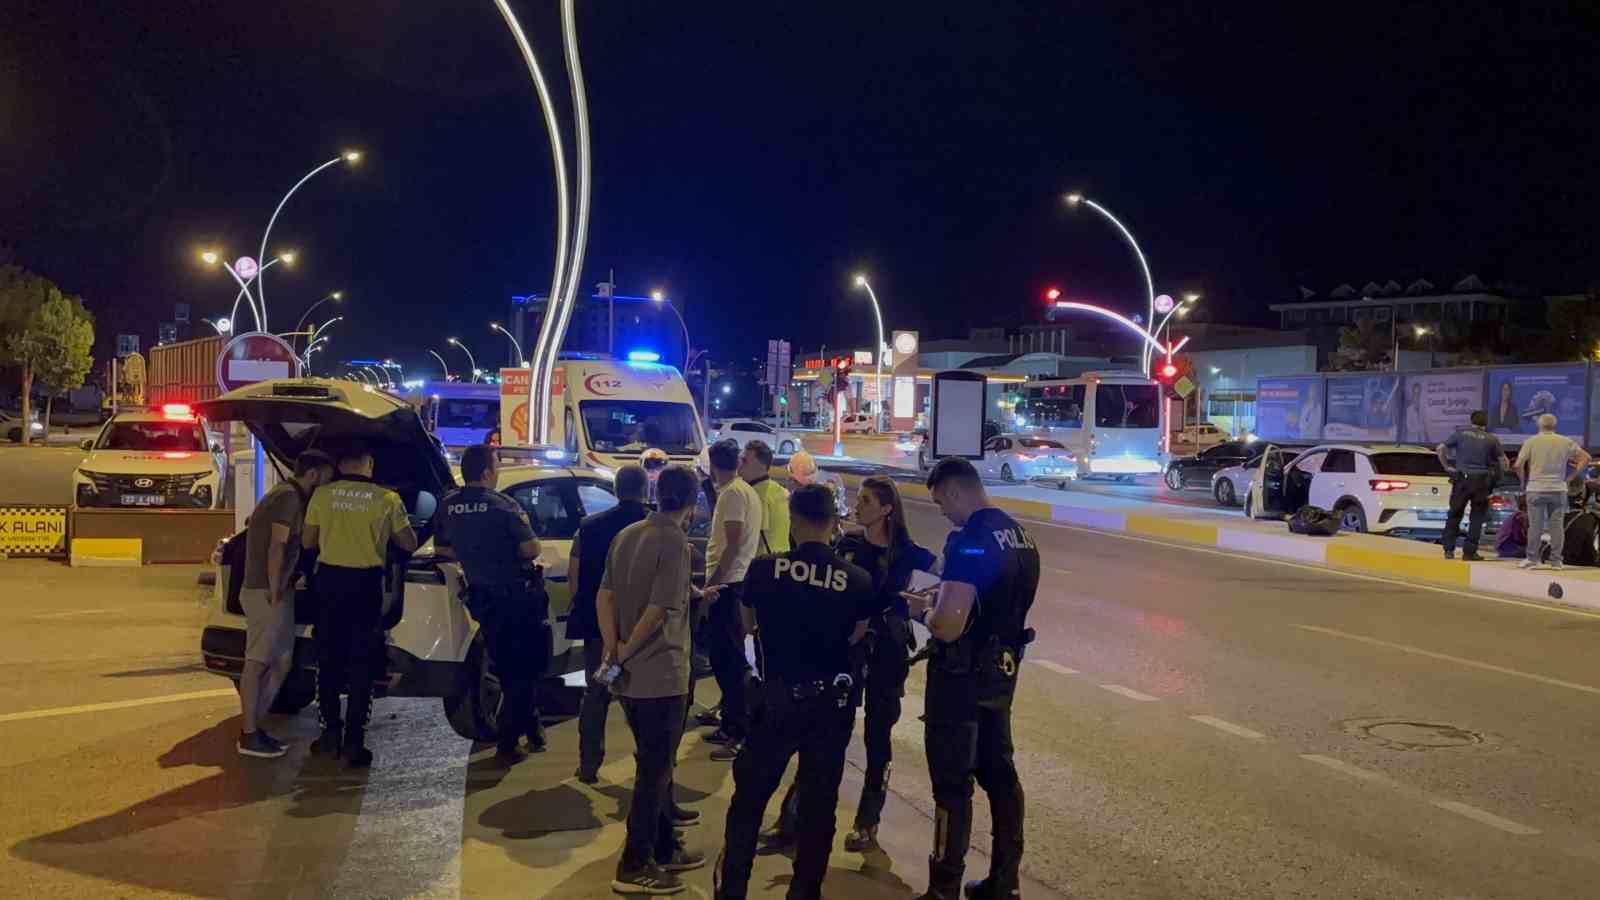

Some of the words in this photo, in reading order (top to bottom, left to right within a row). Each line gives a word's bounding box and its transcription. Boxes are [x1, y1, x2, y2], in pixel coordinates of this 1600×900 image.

[594, 380, 622, 388] 112
[13, 521, 61, 533] ALANI
[774, 557, 849, 592] POLİS
